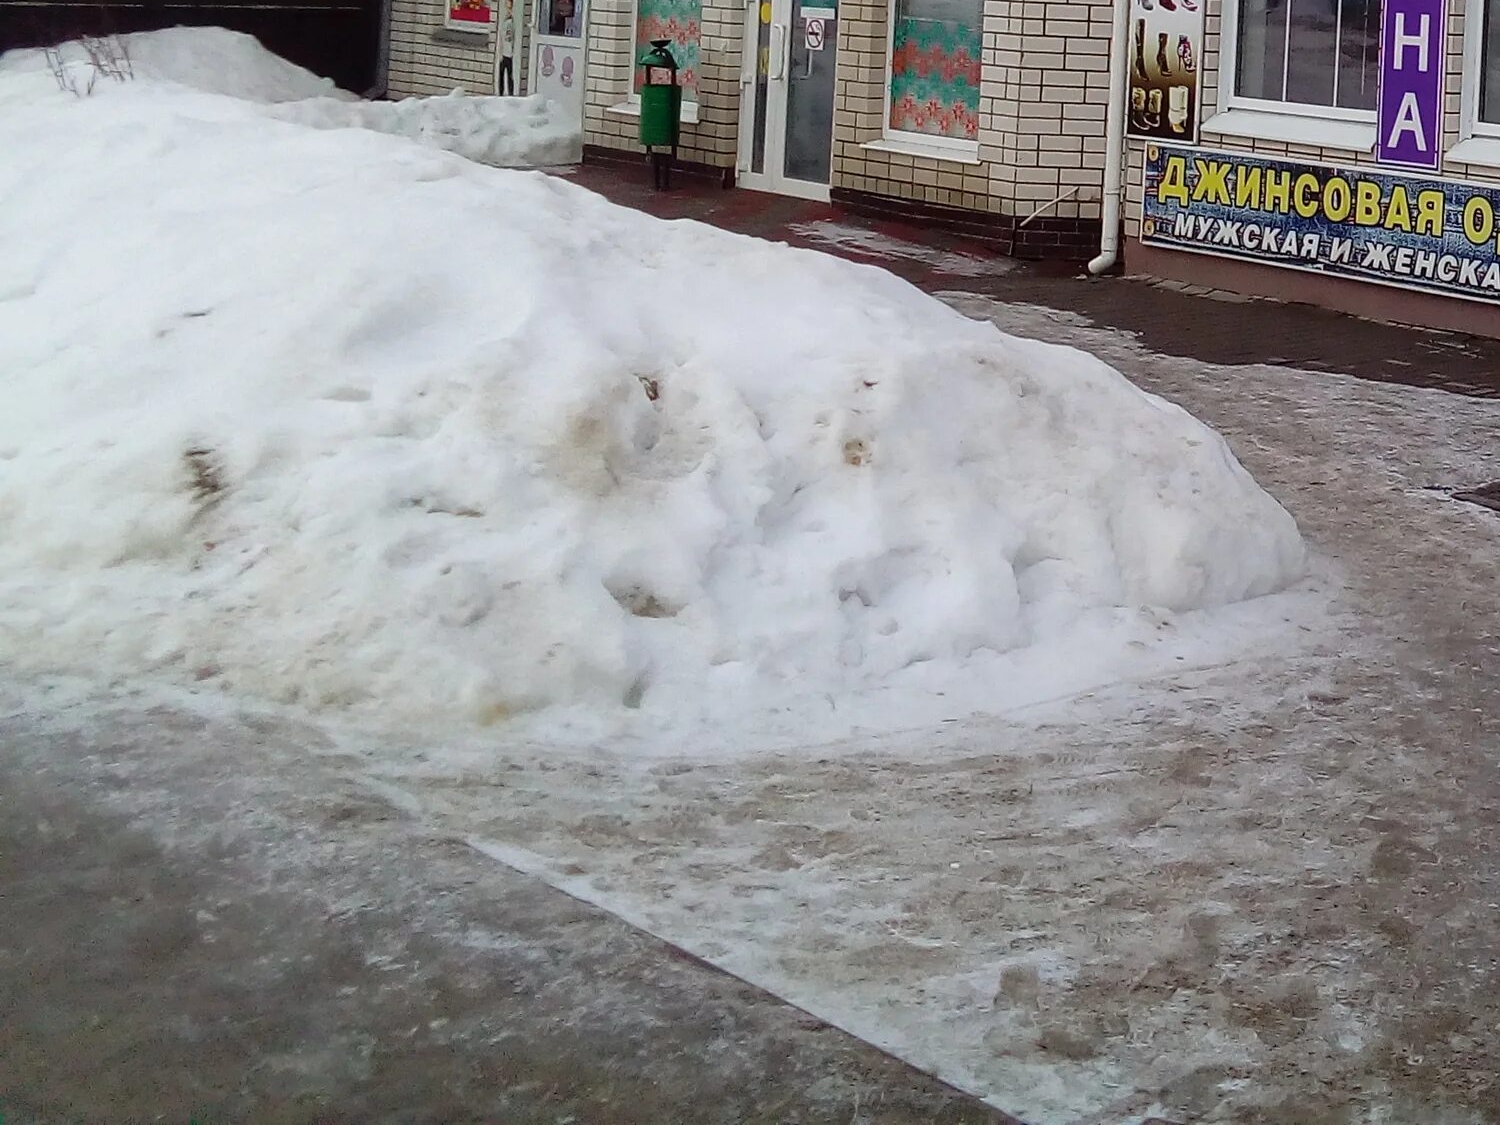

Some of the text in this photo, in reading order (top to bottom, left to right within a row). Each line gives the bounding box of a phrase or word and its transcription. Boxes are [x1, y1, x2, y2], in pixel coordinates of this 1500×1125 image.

[1156, 155, 1445, 237] ДЖИНСОВАЯ
[1172, 213, 1318, 258] МУЖСКАЯ
[1327, 239, 1352, 264] И
